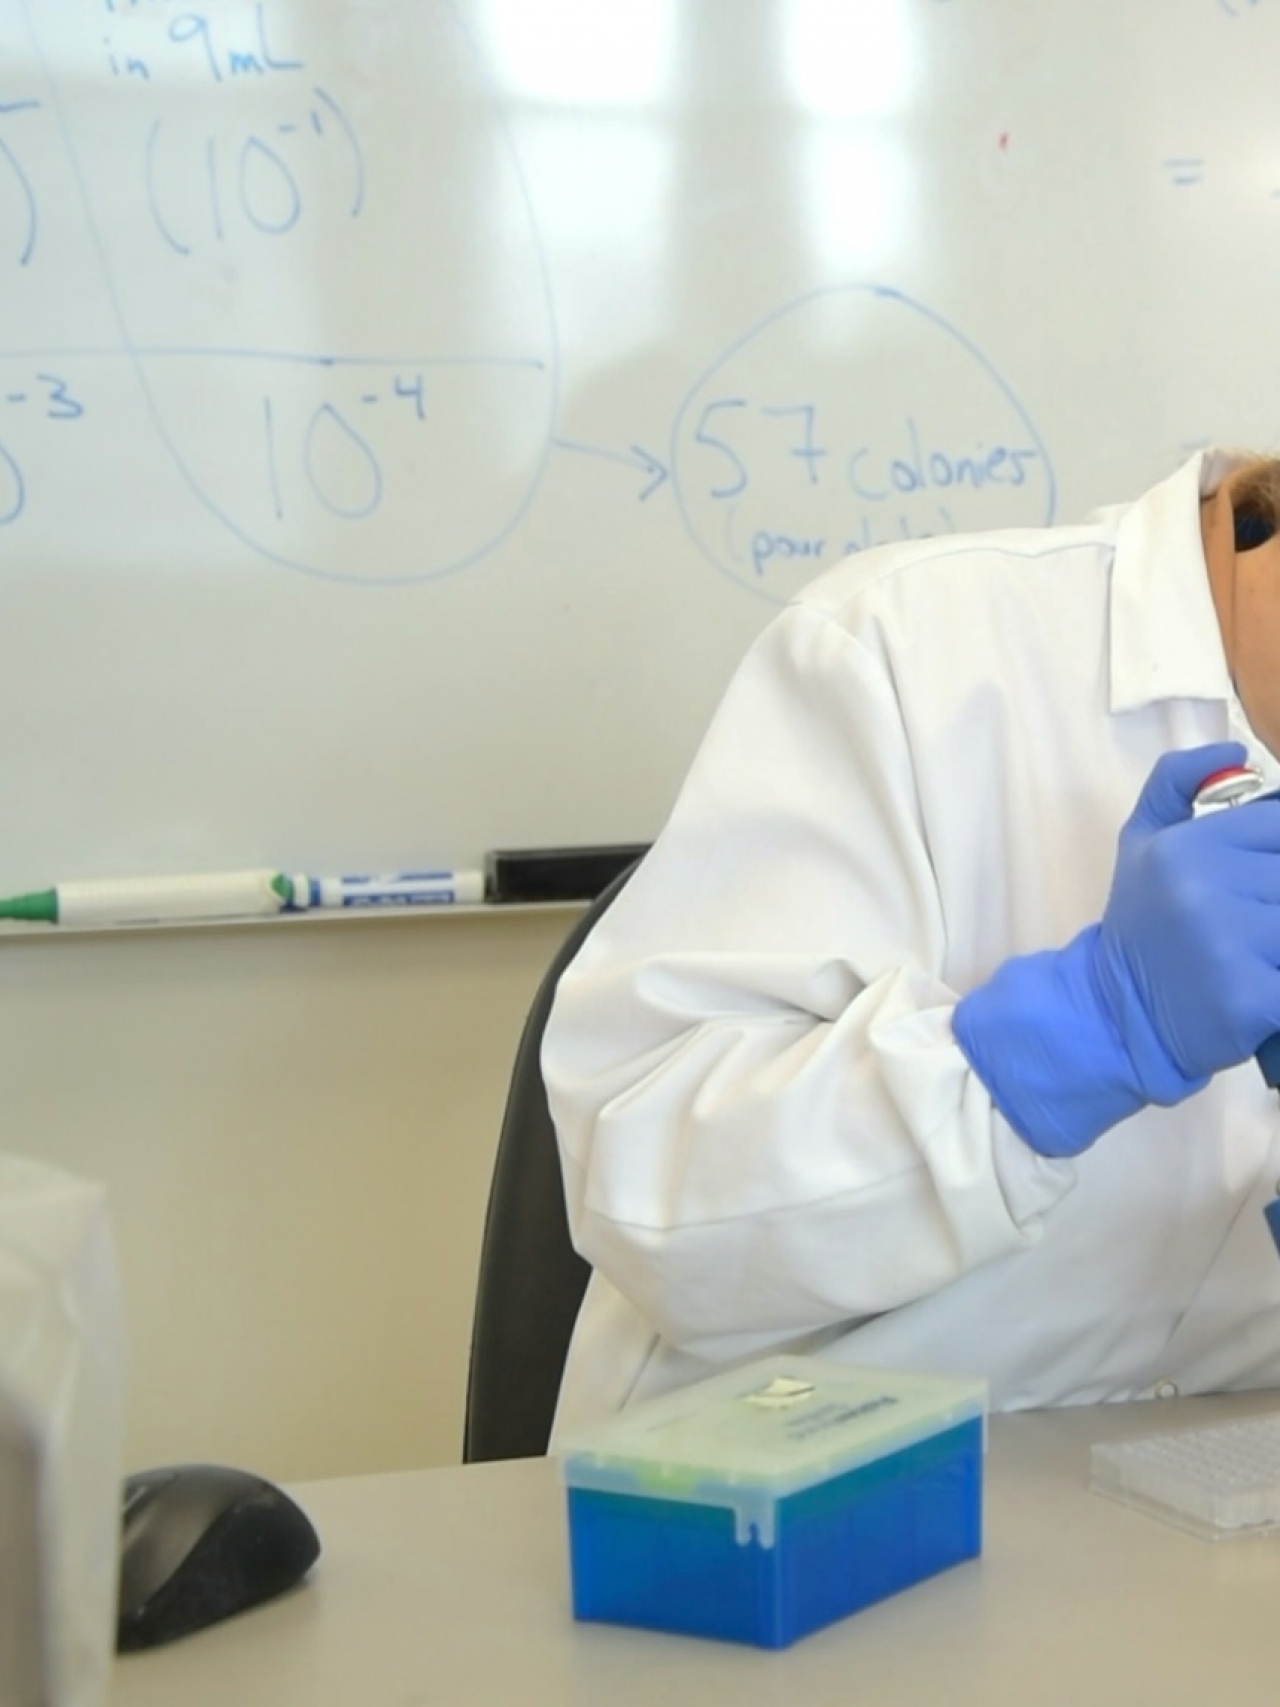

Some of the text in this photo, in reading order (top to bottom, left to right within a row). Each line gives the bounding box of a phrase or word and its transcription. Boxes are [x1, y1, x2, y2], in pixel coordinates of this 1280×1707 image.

[103, 36, 150, 80] in
[694, 398, 1037, 501] 57 colonies
